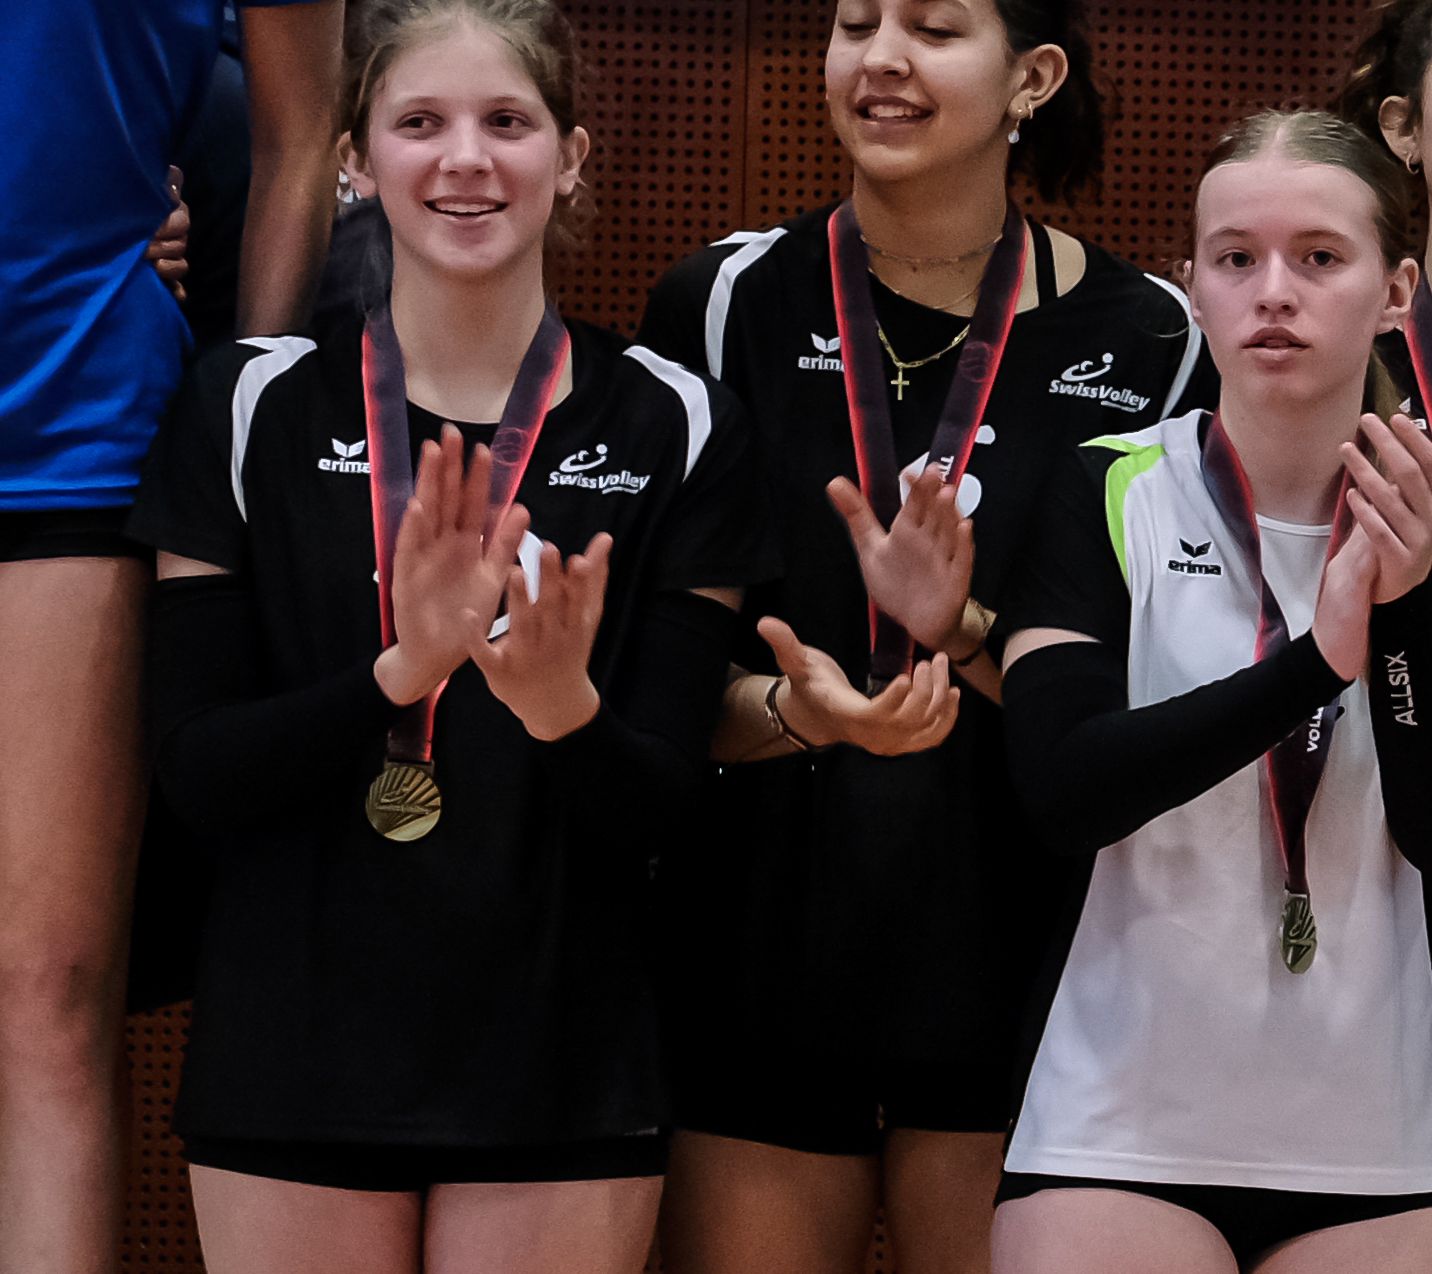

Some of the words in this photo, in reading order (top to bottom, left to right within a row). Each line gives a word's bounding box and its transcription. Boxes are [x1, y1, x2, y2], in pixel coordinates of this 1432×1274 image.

[798, 354, 844, 371] erim
[1168, 559, 1222, 576] erima
[1384, 650, 1418, 726] ALLSIX
